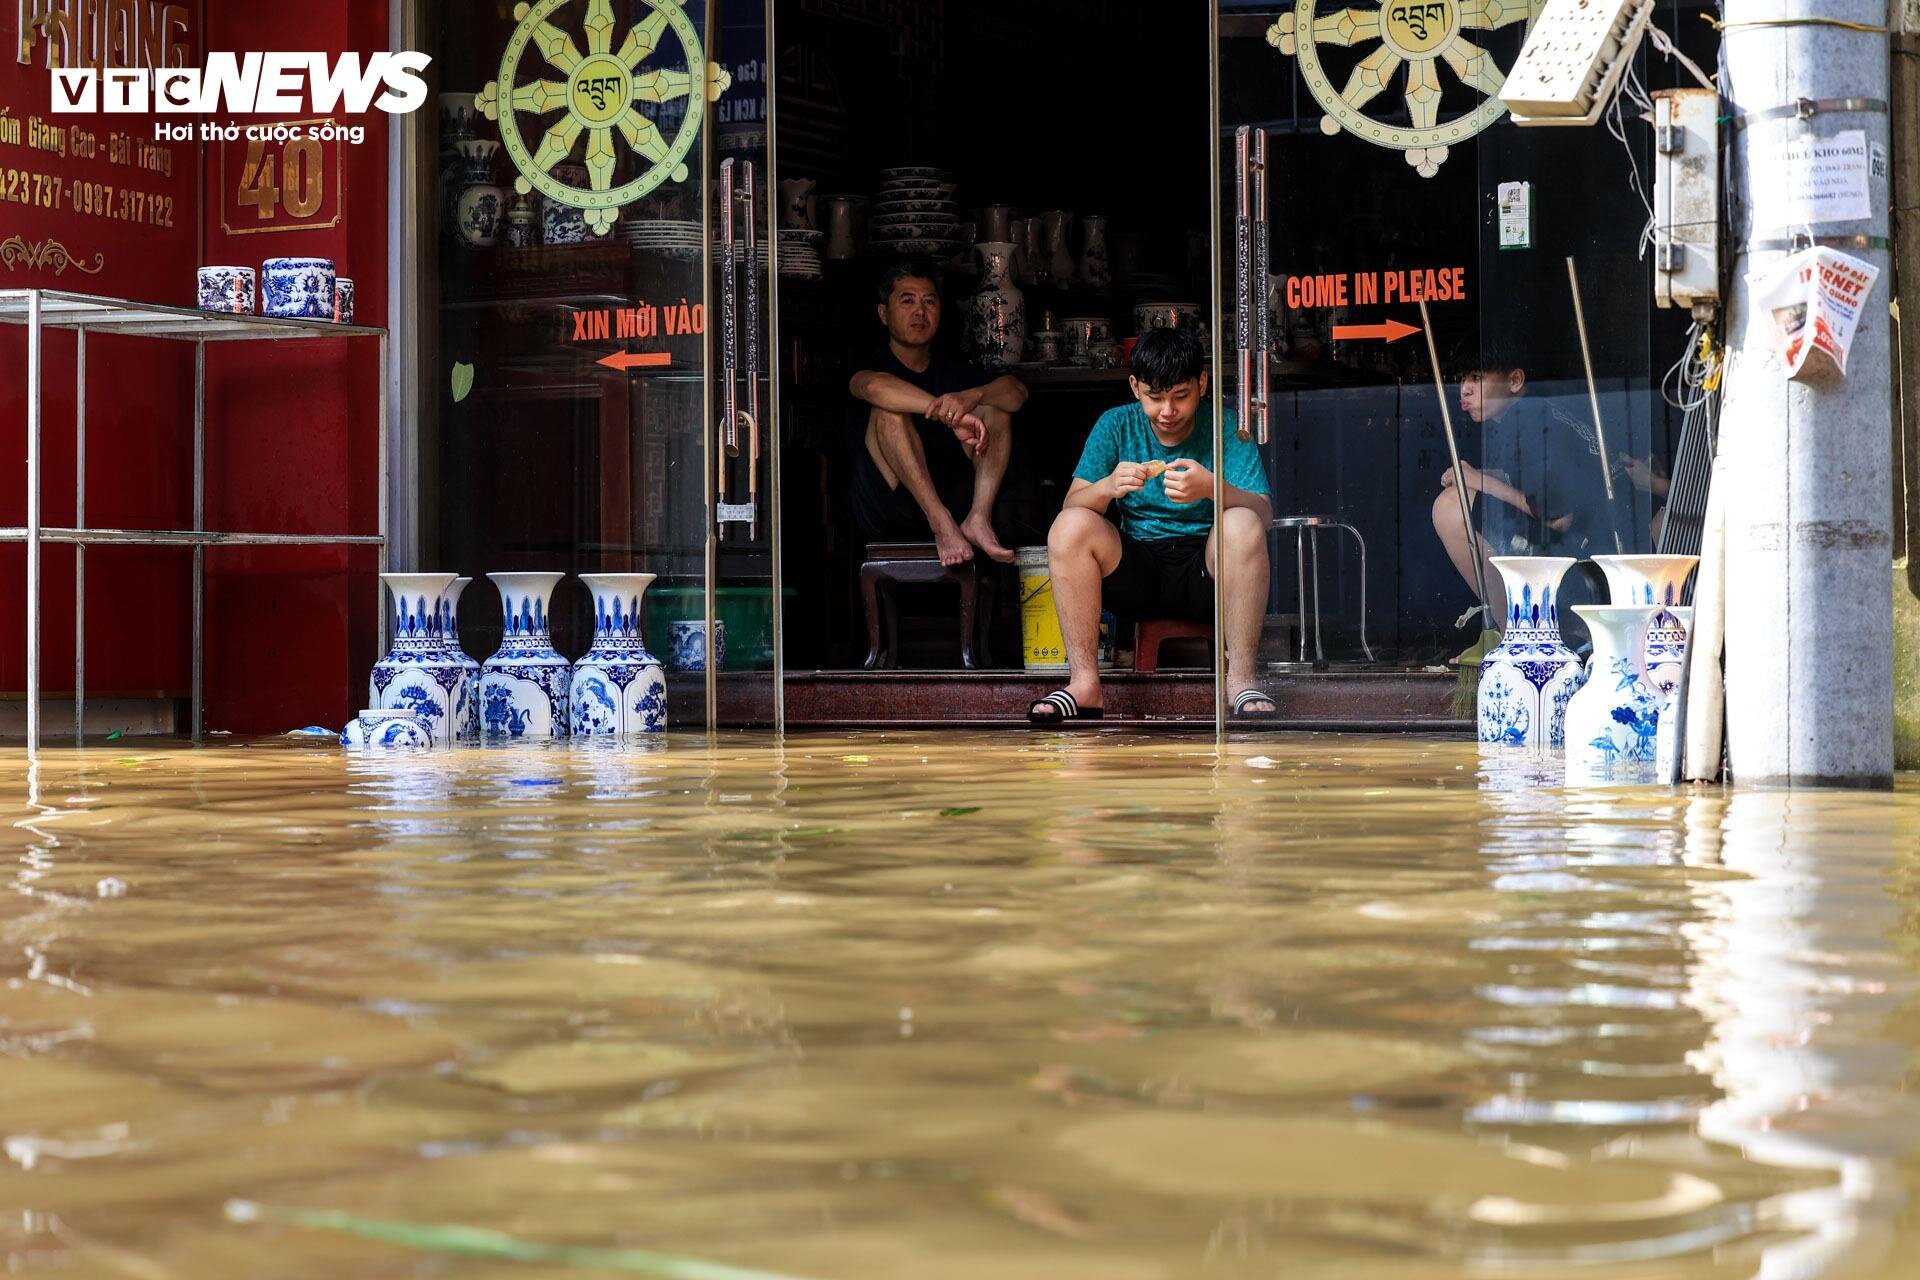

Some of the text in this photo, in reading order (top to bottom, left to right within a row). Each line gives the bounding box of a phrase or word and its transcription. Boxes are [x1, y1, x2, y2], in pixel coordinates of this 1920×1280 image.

[28, 115, 66, 158] Giang
[71, 125, 96, 159] Cao
[1814, 147, 1840, 159] KHO
[238, 135, 322, 219] 40
[1287, 267, 1466, 309] COME IN PLEASE
[572, 298, 705, 341] XIN MỜI VÀO
